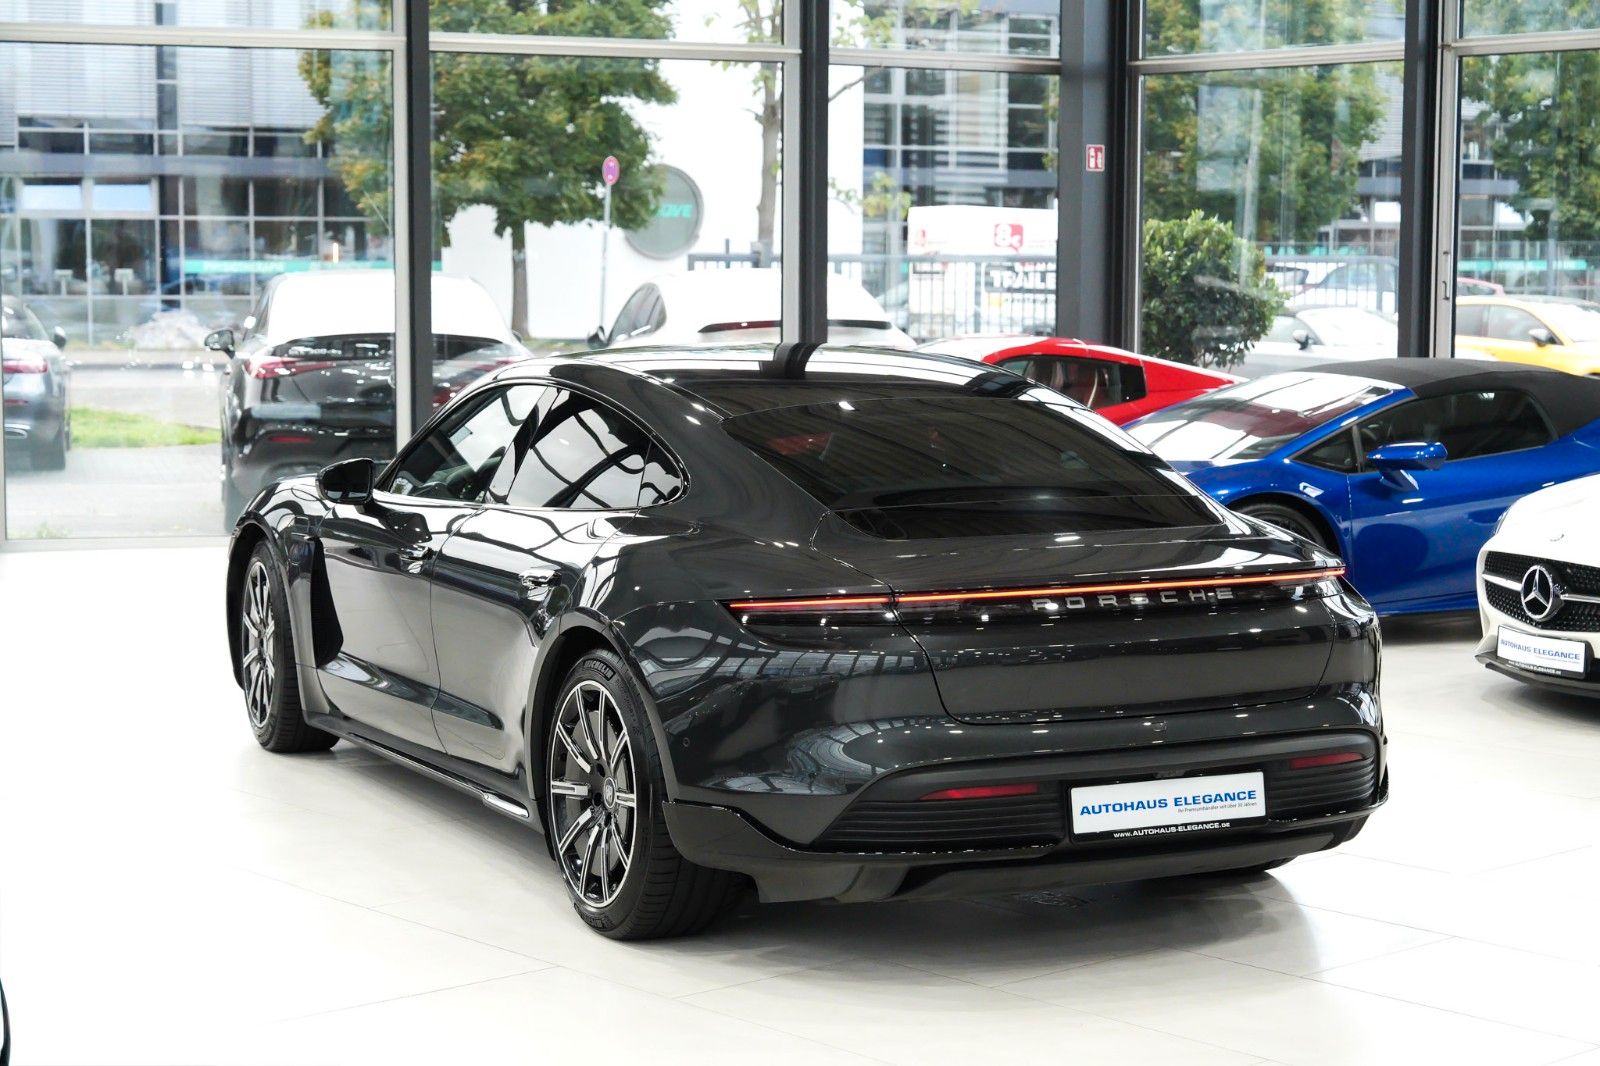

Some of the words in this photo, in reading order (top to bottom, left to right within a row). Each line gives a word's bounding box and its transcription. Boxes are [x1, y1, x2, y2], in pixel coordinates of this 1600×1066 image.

[1031, 588, 1233, 611] PORSCHE
[1500, 638, 1532, 653] AUTOHAUS
[1533, 647, 1581, 661] ELEGANCE
[1079, 798, 1168, 817] AUTOHAUS
[1174, 790, 1257, 807] ELEGANCE
